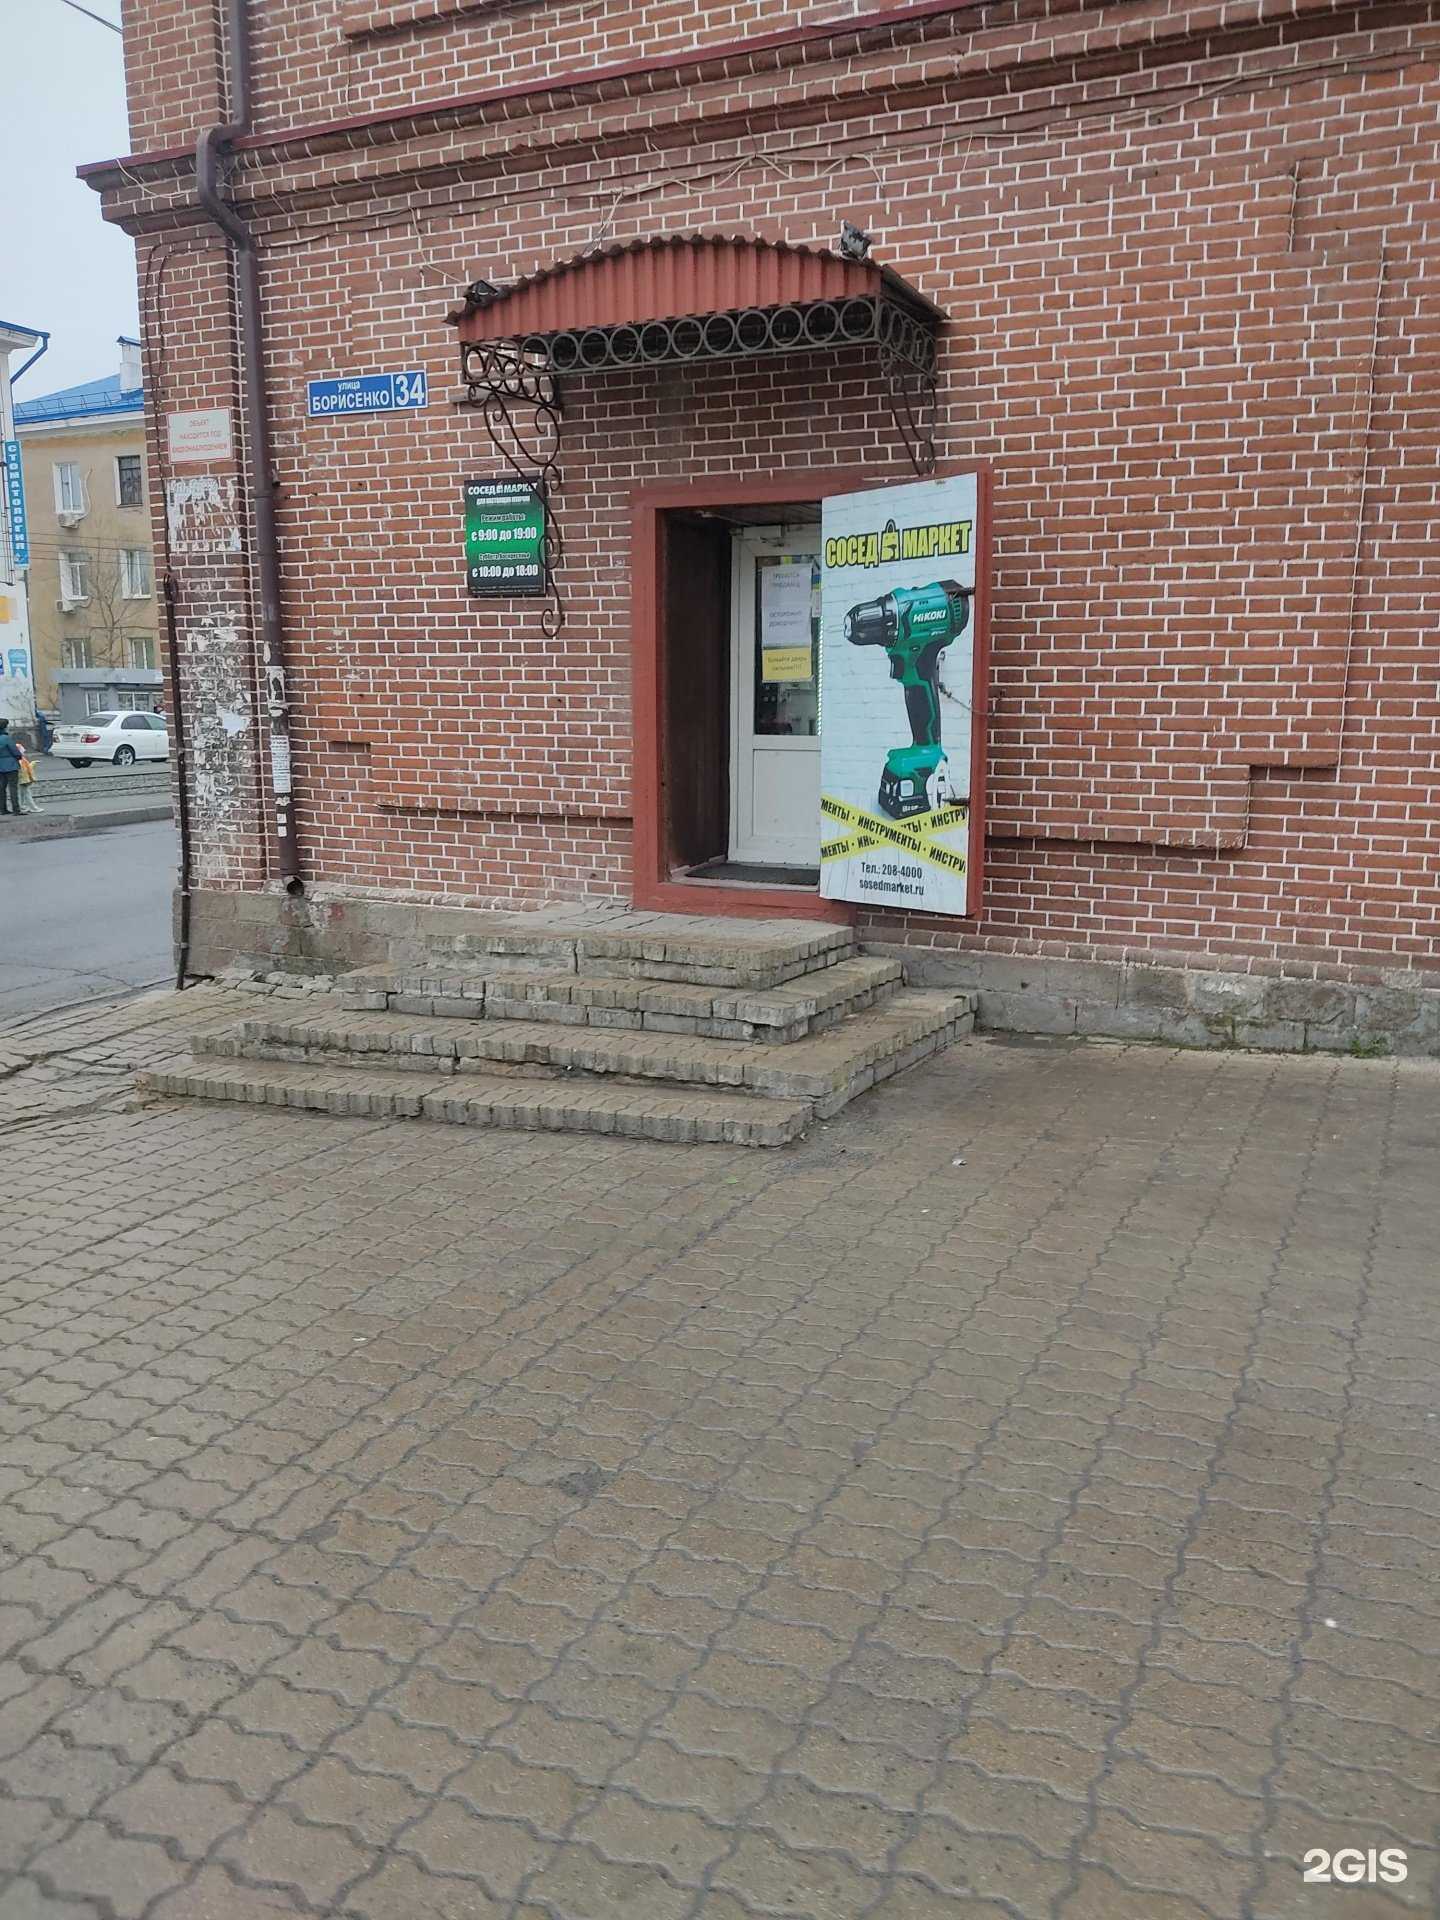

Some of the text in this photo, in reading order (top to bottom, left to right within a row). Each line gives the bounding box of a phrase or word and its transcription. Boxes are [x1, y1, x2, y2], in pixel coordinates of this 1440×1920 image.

[312, 374, 425, 411] БОРИСЕНКО 34
[337, 381, 360, 392] улица
[7, 444, 25, 550] СТОМАТОЛОГИЯ
[468, 484, 497, 496] СОСЕД
[478, 529, 498, 541] 9:00
[499, 530, 512, 542] до
[512, 527, 537, 540] 19:00
[825, 520, 973, 569] СОСЕД МАРКЕТ
[479, 566, 501, 577] 10:00
[502, 567, 514, 578] до
[515, 564, 538, 577] 18:00
[930, 806, 967, 828] ИНСТРУ
[820, 798, 966, 873] МЕНТЫ ИНСТРУМЕНТЫ ИНСТРУ
[861, 862, 923, 879] Тел.: 208-4000
[859, 878, 925, 896] sosedmarket.ru
